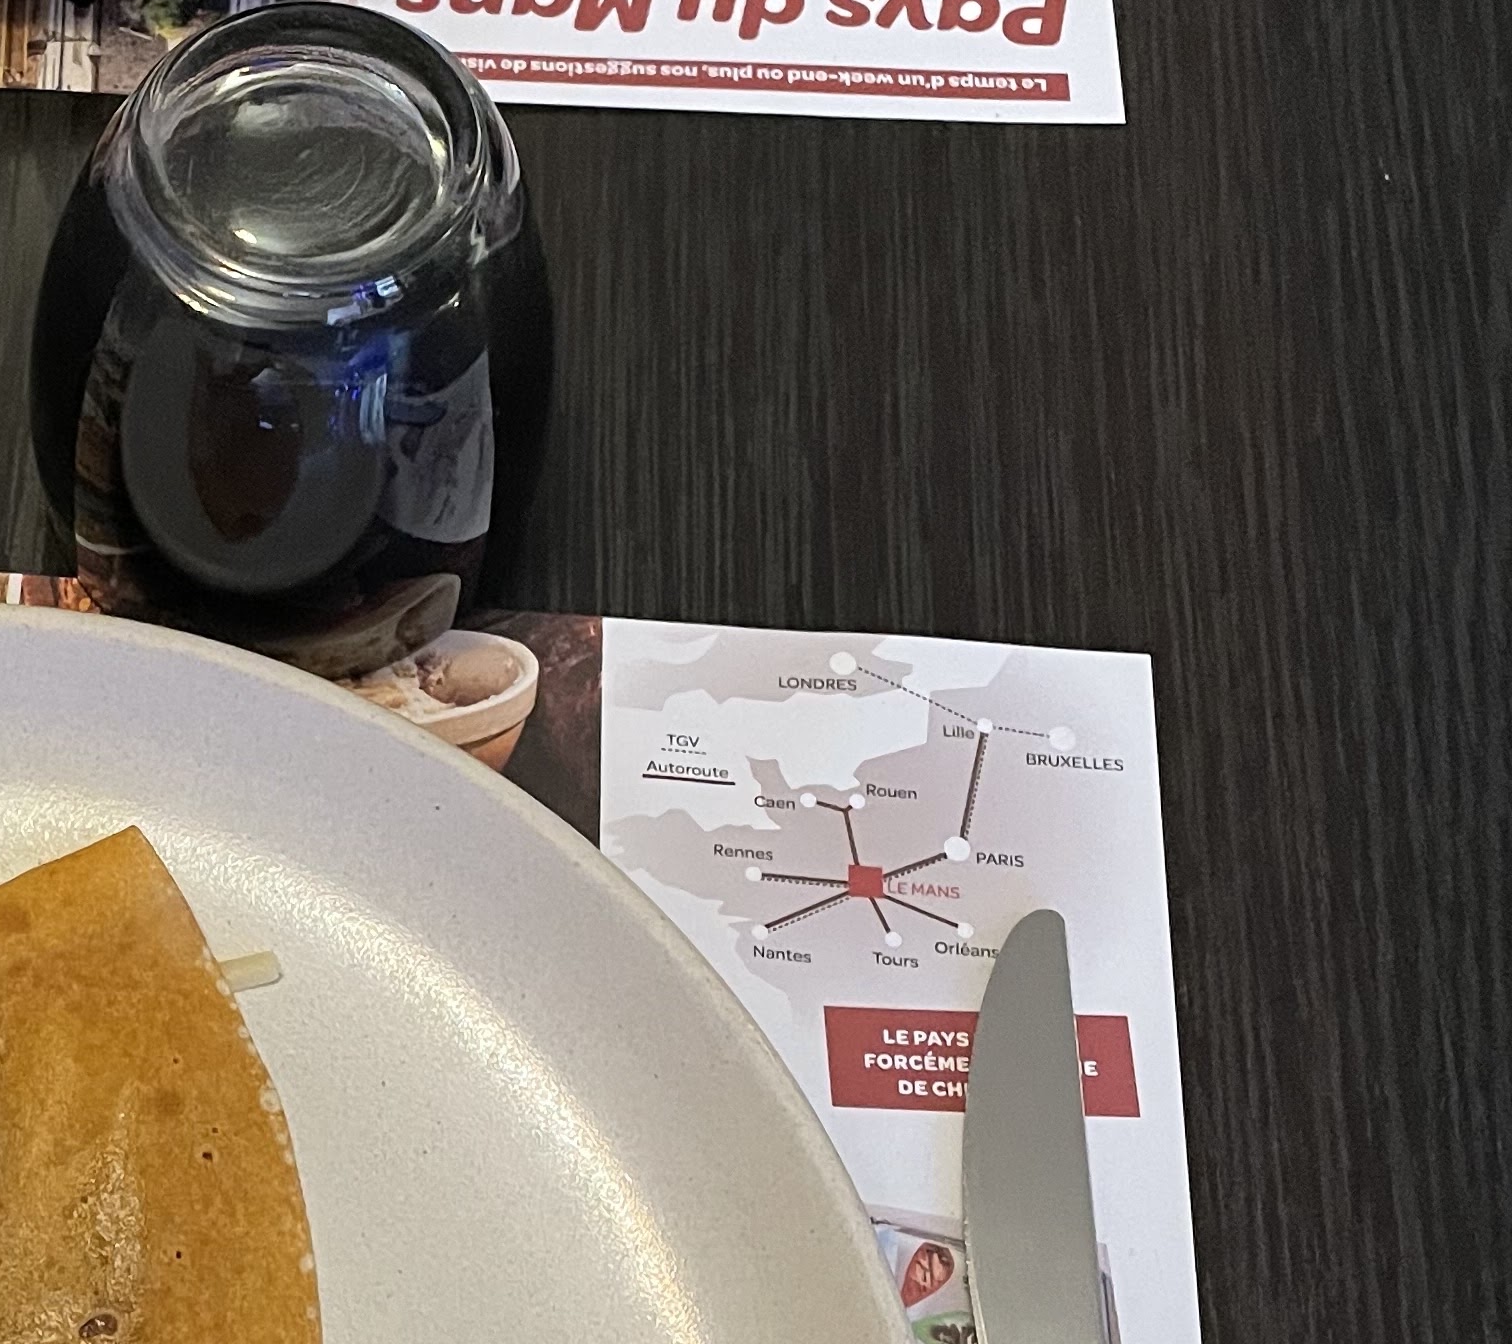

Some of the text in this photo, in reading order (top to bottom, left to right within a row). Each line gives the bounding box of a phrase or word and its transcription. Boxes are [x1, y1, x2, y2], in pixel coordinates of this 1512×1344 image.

[500, 58, 1047, 91] Le temps d'un week-end ou plus, nos suggestions de
[778, 676, 857, 691] LONDRES
[943, 725, 975, 739] Lille
[666, 734, 700, 748] TGV
[646, 761, 729, 779] Autoroute
[1026, 753, 1124, 772] BRUXELLES
[866, 784, 917, 801] Rouen
[754, 794, 796, 811] Caen
[713, 844, 773, 861] Rennes
[976, 852, 1024, 868] PARIS
[911, 883, 960, 899] MANS
[753, 945, 812, 964] Nantes
[934, 940, 1000, 959] Orléans
[873, 951, 919, 969] Tours
[883, 1029, 970, 1048] LE PAYS
[864, 1050, 970, 1072] FORCÉME
[898, 1080, 925, 1096] DE
